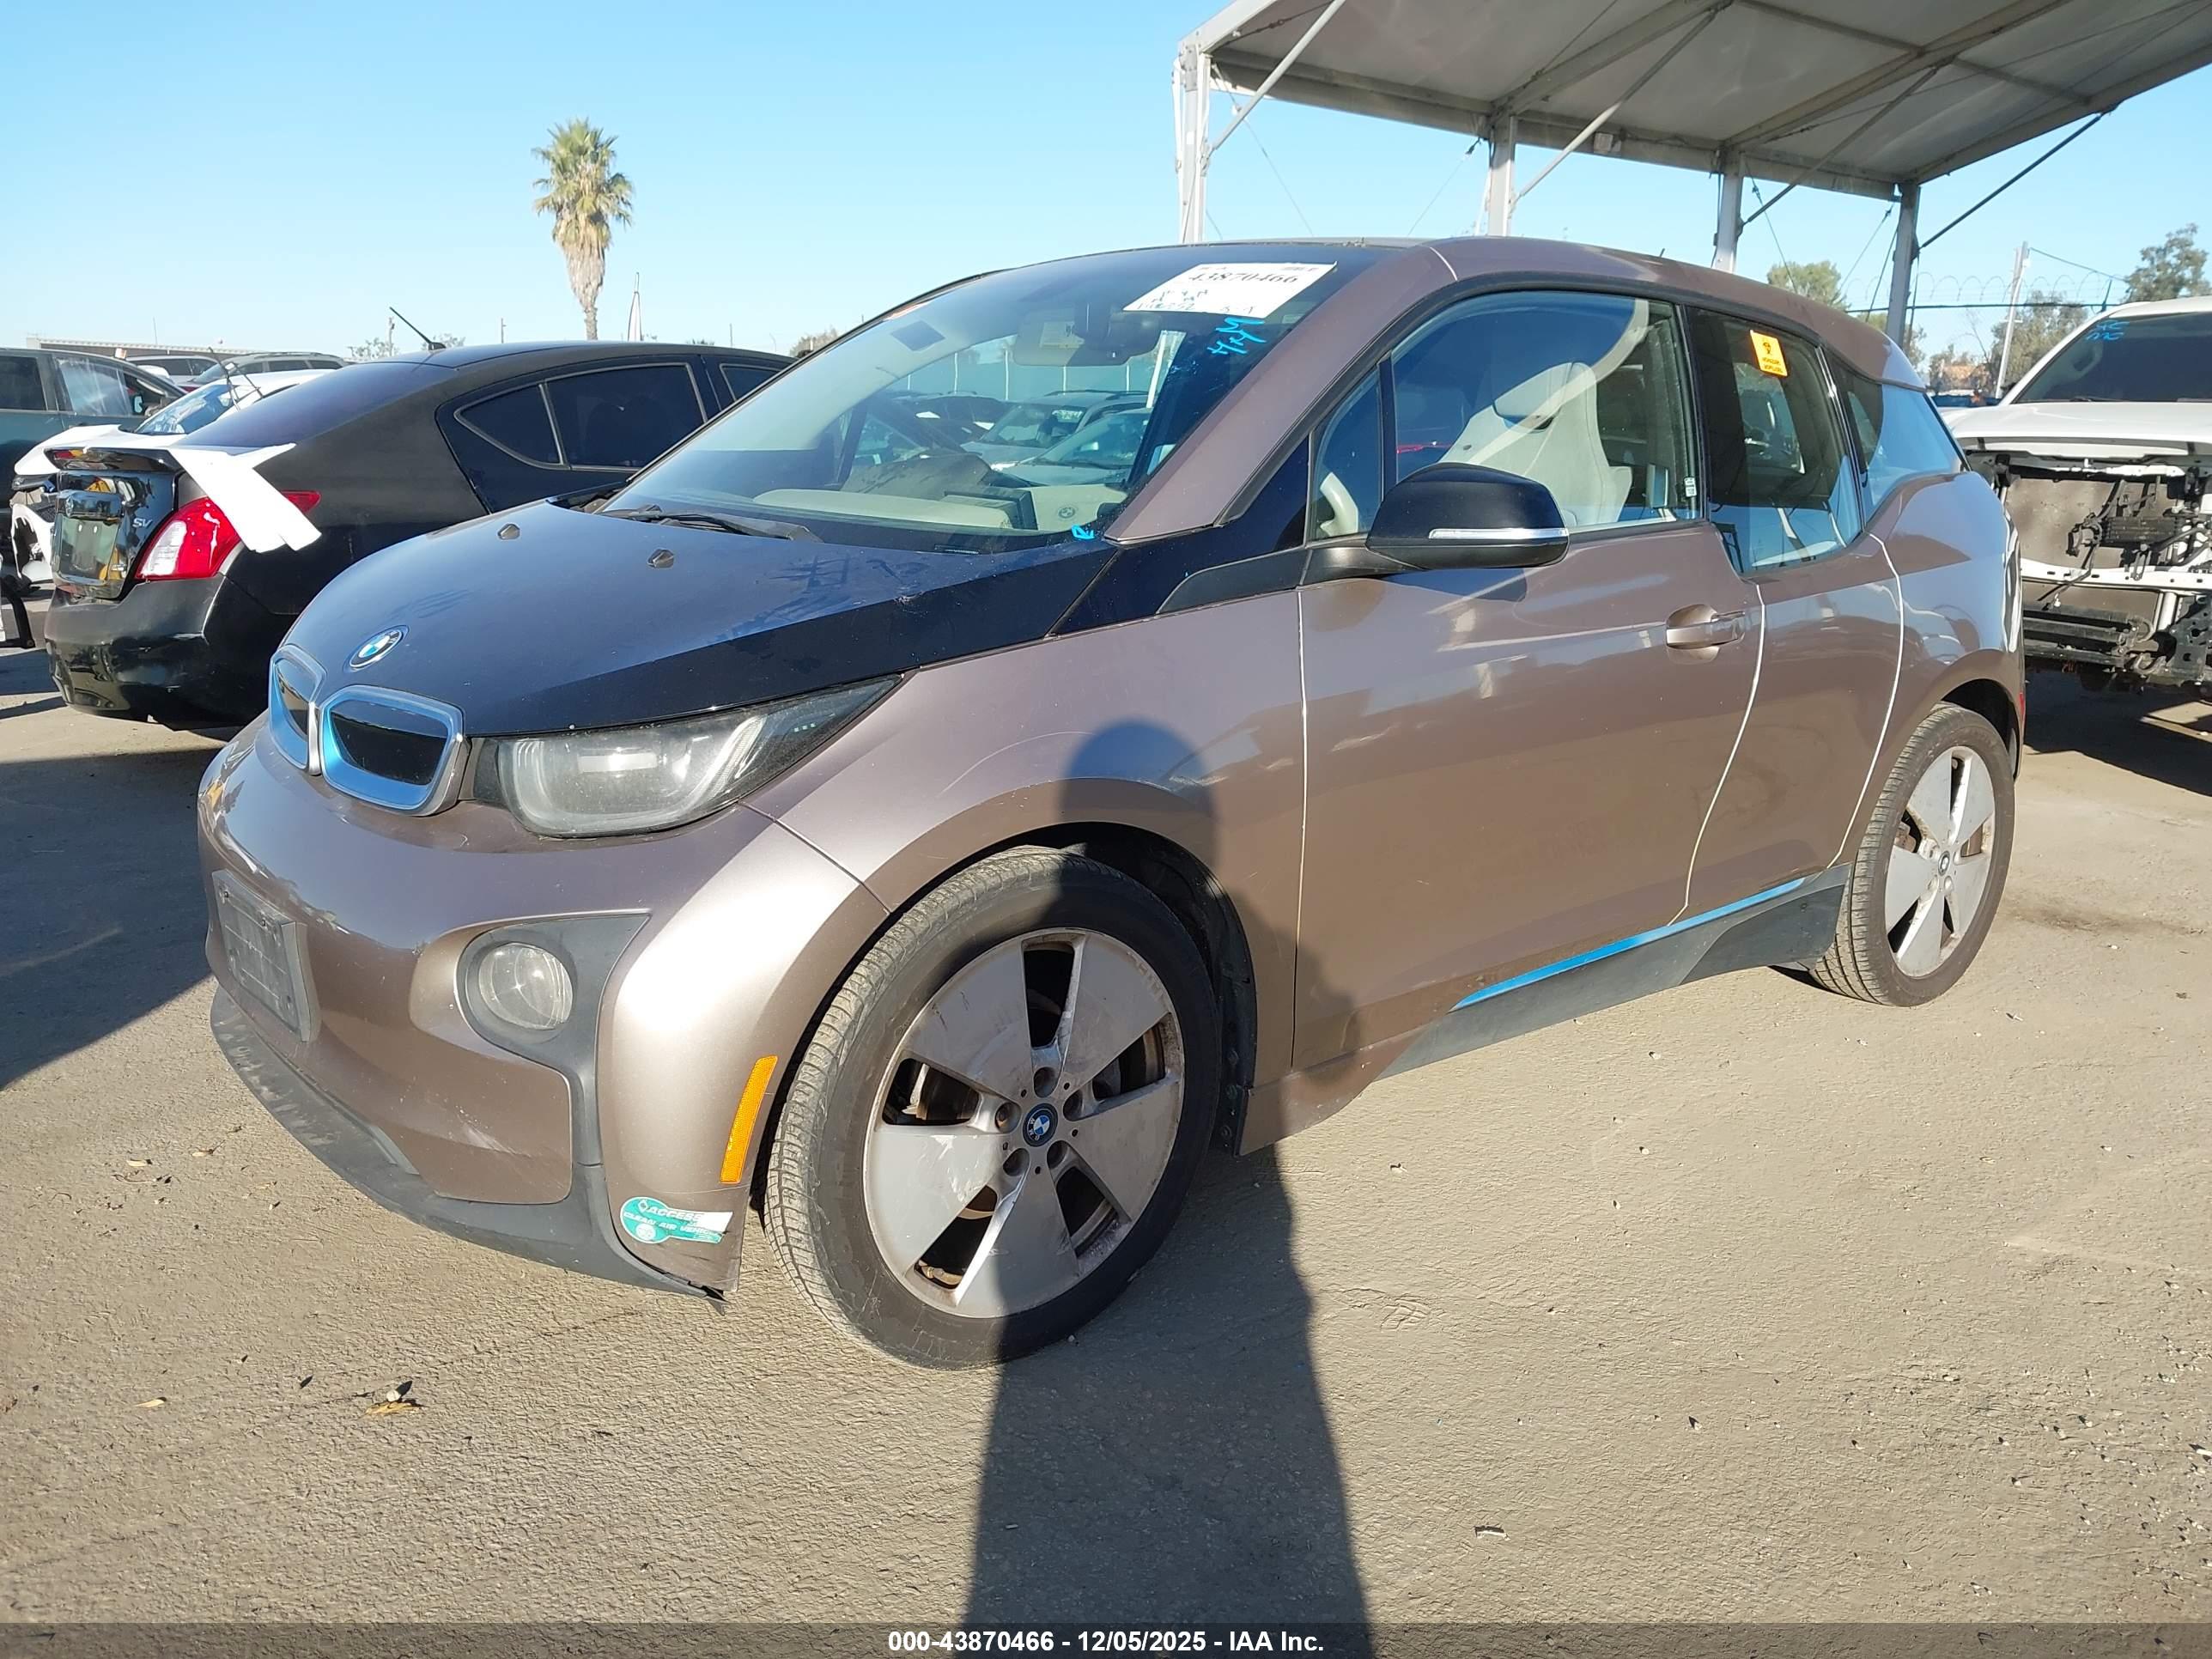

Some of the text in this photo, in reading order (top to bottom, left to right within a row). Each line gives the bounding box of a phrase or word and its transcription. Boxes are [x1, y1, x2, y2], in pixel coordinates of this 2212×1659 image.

[1188, 271, 1299, 283] 43870466
[132, 518, 153, 528] SV
[647, 1206, 702, 1221] ACCESS
[623, 1212, 657, 1225] CLEAN
[658, 1222, 678, 1231] AIR
